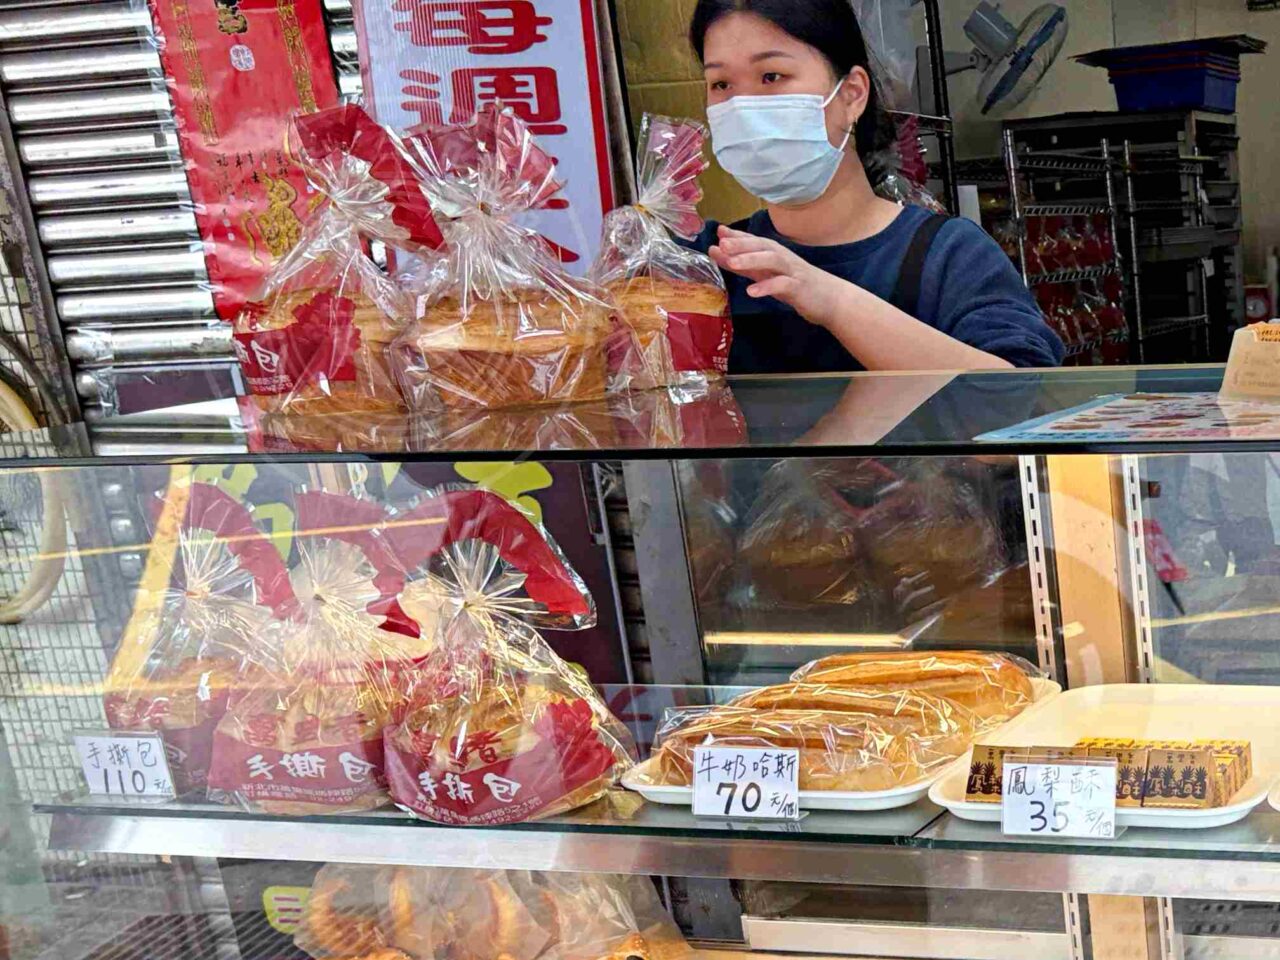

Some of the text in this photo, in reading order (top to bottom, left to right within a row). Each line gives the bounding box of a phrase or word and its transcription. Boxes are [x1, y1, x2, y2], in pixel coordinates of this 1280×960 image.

[87, 741, 157, 770] 手撕包
[246, 751, 377, 783] 手撕包
[697, 750, 797, 783] 牛奶哈斯
[103, 768, 146, 794] 110
[1007, 765, 1100, 799] 鳳梨酥
[716, 782, 762, 815] 70
[1029, 800, 1070, 833] 35
